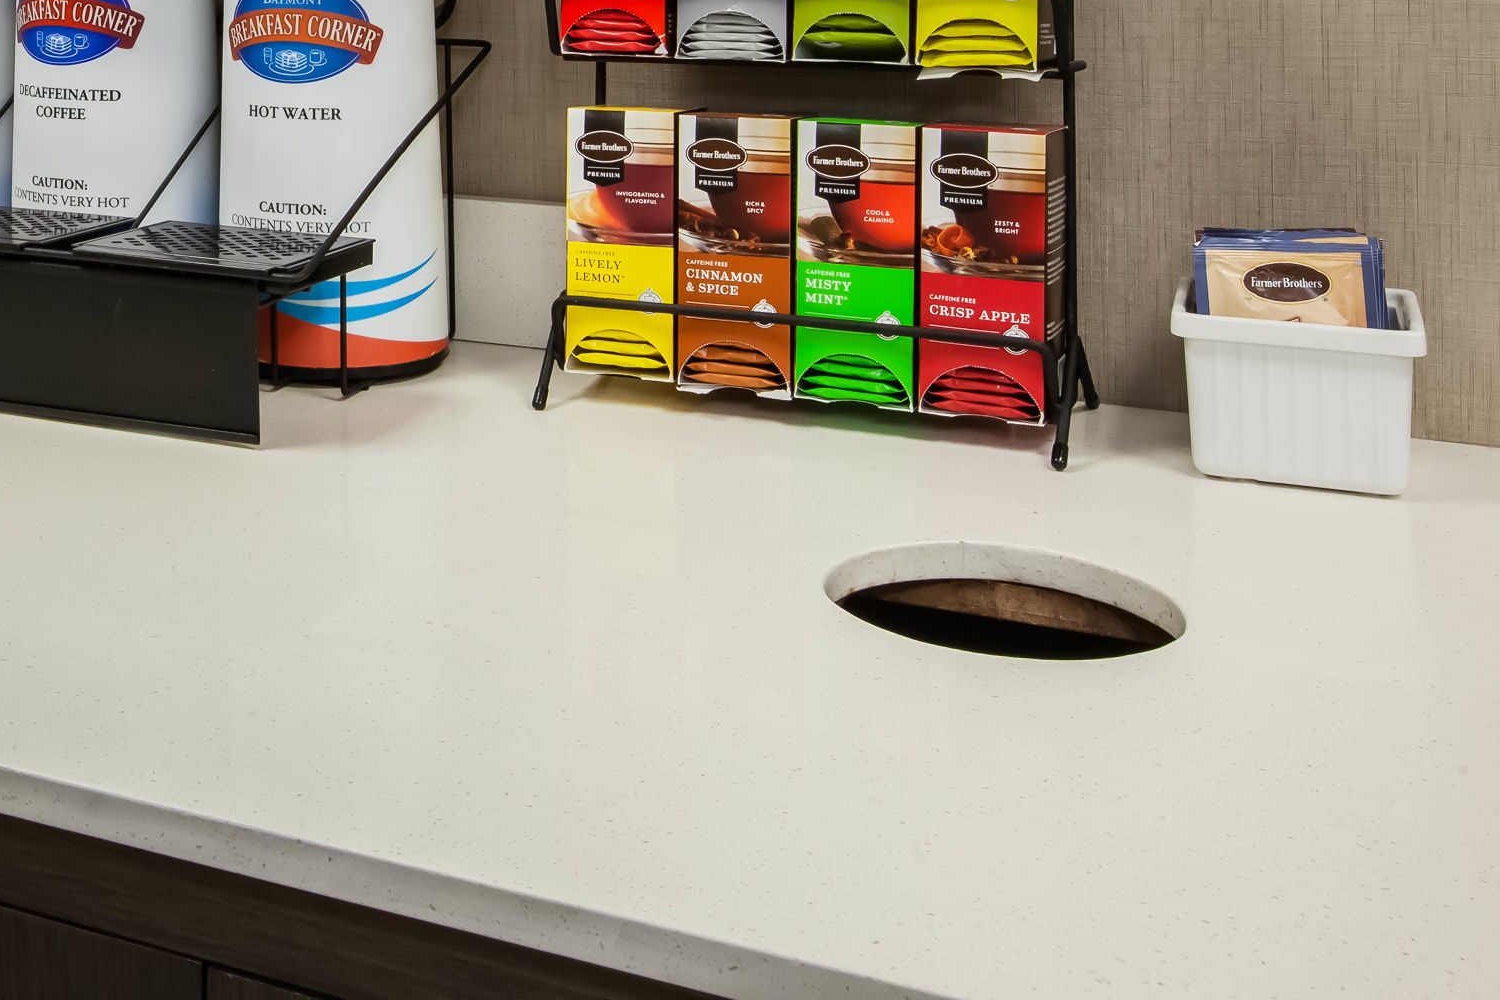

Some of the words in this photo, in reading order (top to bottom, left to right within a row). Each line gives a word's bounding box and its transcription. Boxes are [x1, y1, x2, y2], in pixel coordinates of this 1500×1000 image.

[72, 1, 138, 37] CORNER
[230, 13, 303, 48] BREAKFAST
[307, 15, 377, 52] CORNER
[19, 83, 122, 102] DECAFFEINATED
[36, 105, 86, 120] COFFEE
[248, 104, 279, 119] HOT
[282, 107, 342, 121] WATER
[581, 141, 601, 151] Farmer
[601, 142, 628, 152] Brothers
[692, 149, 713, 159] Farmer
[713, 150, 741, 160] Brothers
[813, 156, 835, 166] Farmer
[835, 157, 864, 168] Brothers
[937, 164, 960, 175] Farmer
[961, 166, 991, 178] Brothers
[32, 175, 88, 191] CAUTION:
[698, 179, 734, 187] PREMIUM
[15, 186, 58, 206] CONTENTS
[61, 195, 94, 208] VERY
[97, 197, 130, 209] HOT
[615, 190, 660, 198] INVIGORATING
[819, 187, 856, 196] PREMIUM
[624, 197, 657, 205] FLAVORFUL
[944, 196, 984, 206] PREMIUM
[259, 200, 327, 216] CAUTION:
[231, 213, 292, 233] CONTENTS
[296, 221, 334, 234] VERY
[863, 216, 894, 224] CALMING
[994, 219, 1014, 228] ZESTY
[994, 227, 1019, 235] BRIGHT
[575, 258, 623, 270] LIVELY
[686, 258, 714, 267] CAFFEINE
[714, 260, 729, 268] FREE
[686, 268, 763, 284] CINNAMON
[805, 268, 835, 277] CAFFEINE
[835, 271, 851, 279] FREE
[805, 277, 852, 292] MISTY
[1251, 276, 1282, 288] Farmer
[1282, 277, 1323, 289] Brothers
[686, 282, 695, 292] &
[698, 283, 739, 296] SPICE
[929, 293, 960, 303] CAFFEINE
[960, 296, 976, 304] FREE
[929, 304, 975, 319] CRISP
[978, 310, 1031, 325] APPLE
